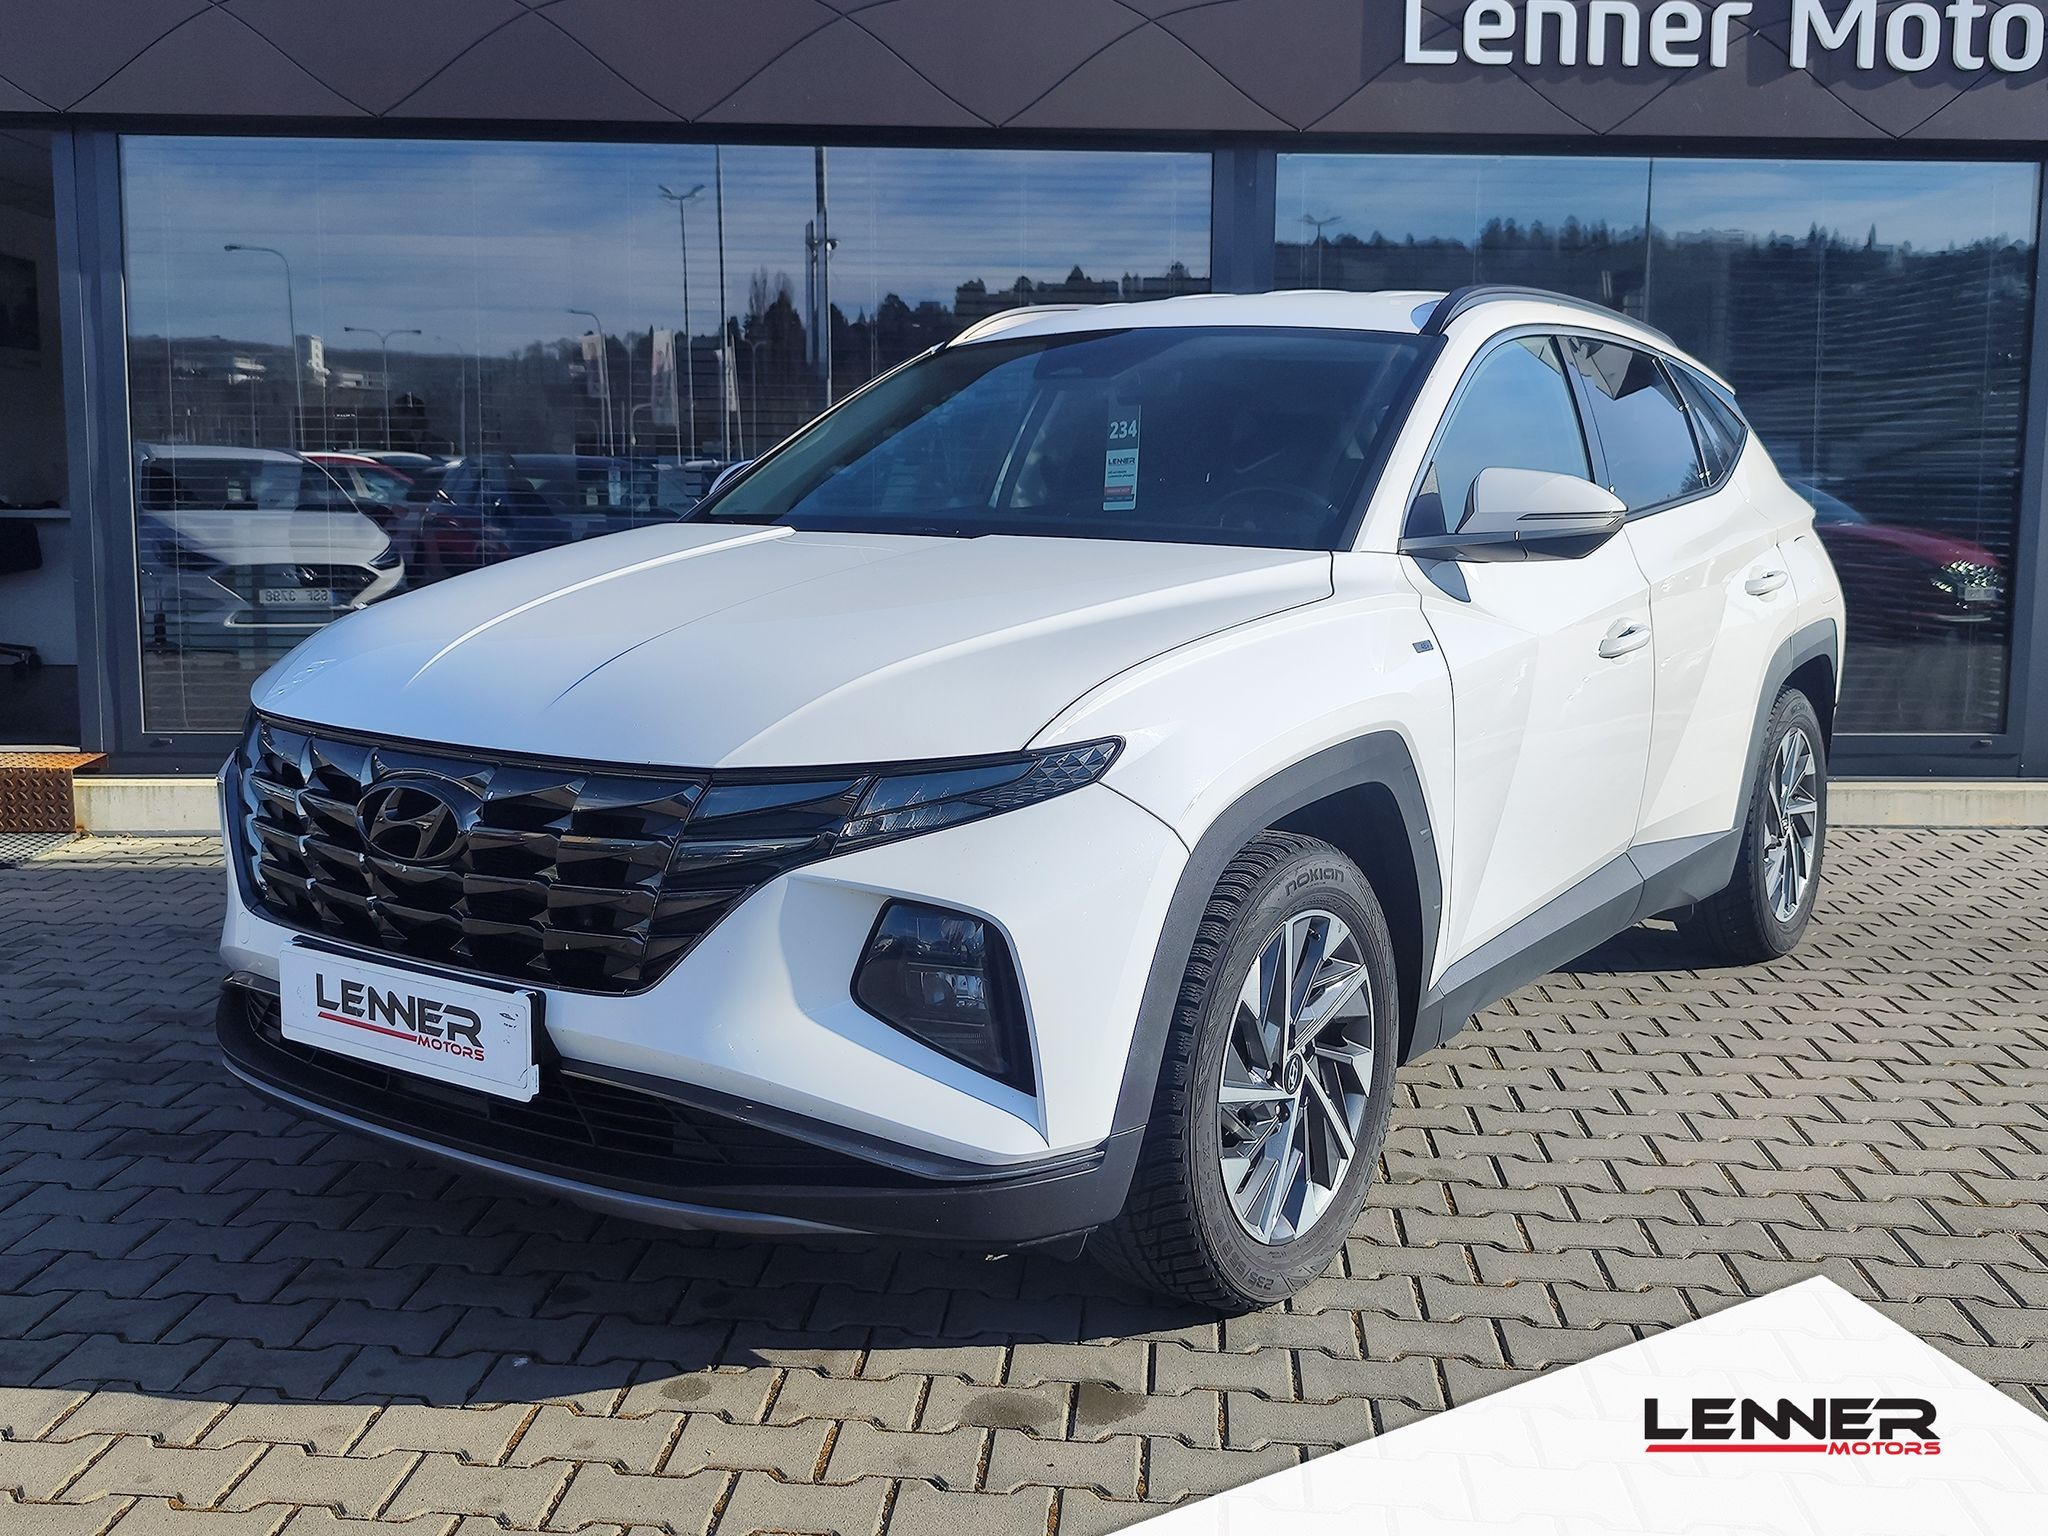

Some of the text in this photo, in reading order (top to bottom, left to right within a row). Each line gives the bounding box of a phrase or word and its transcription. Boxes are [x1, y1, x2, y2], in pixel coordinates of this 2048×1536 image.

[1404, 0, 2045, 71] Lenner Moto
[1109, 420, 1138, 440] 234
[1107, 456, 1136, 465] LENNER
[316, 973, 485, 1048] LENNER
[417, 1034, 485, 1062] MOTORS
